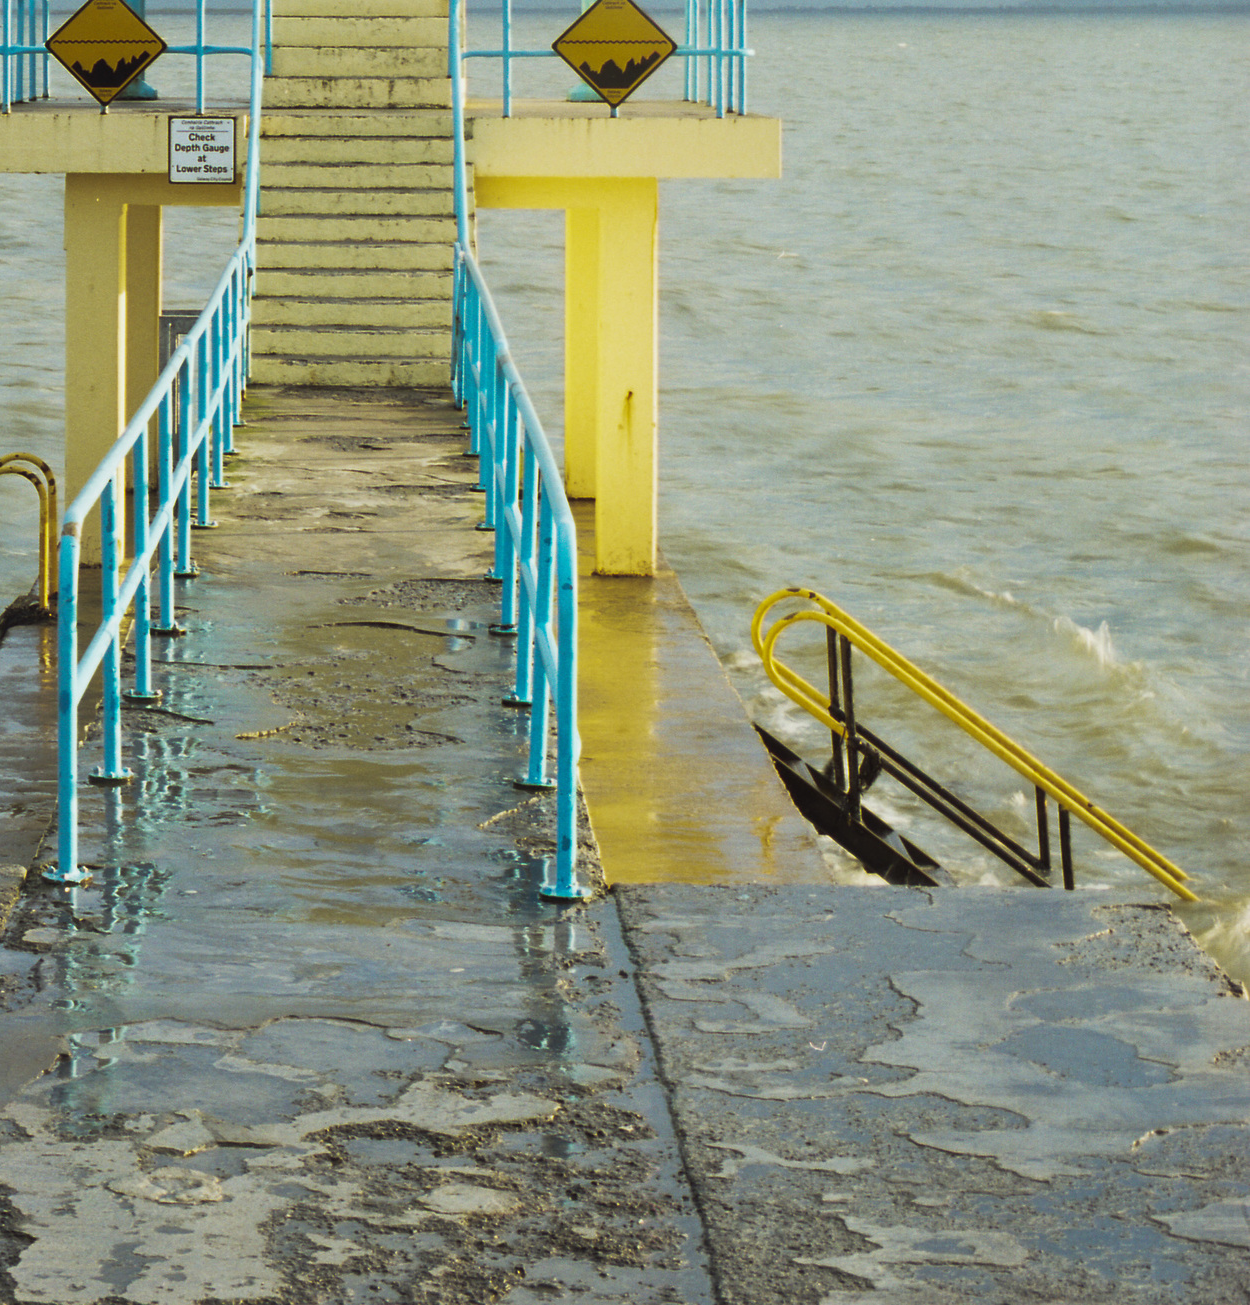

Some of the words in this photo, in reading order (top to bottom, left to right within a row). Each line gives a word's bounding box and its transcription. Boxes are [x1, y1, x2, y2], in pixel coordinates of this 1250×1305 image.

[188, 133, 215, 141] Check
[174, 143, 200, 153] Depth
[202, 143, 230, 153] Gauge
[176, 164, 202, 173] Lower
[203, 164, 228, 174] Steps
